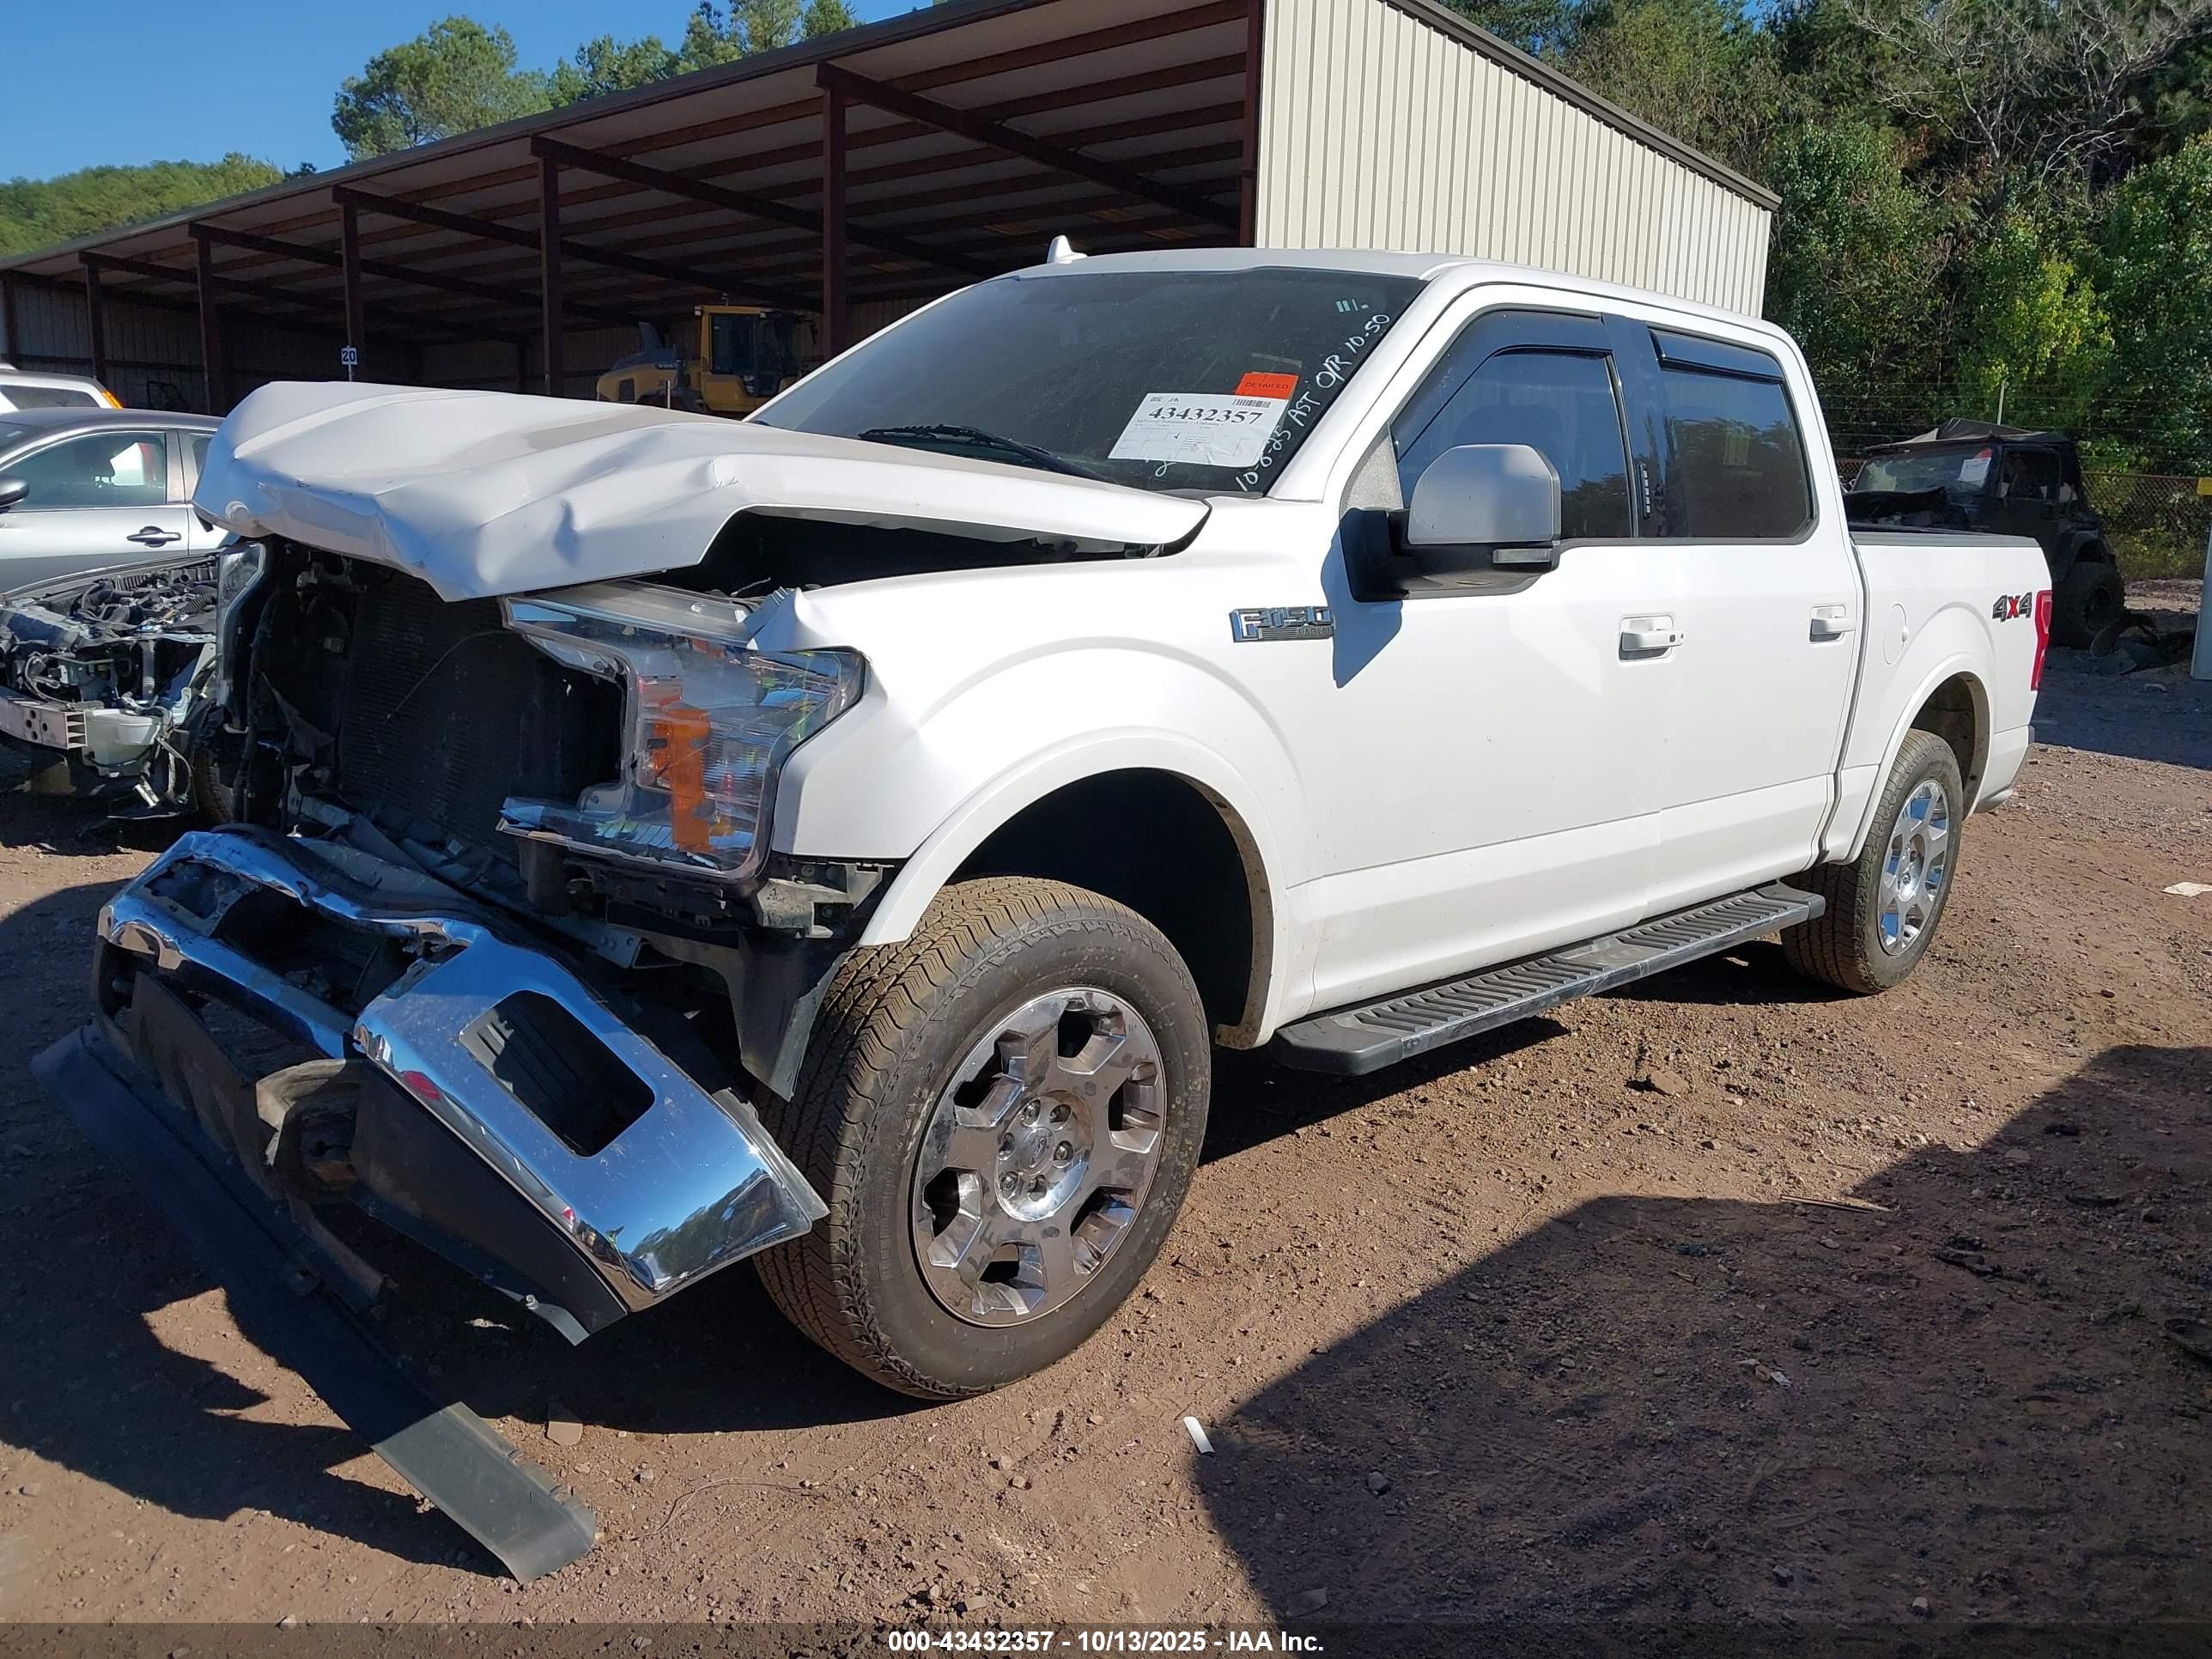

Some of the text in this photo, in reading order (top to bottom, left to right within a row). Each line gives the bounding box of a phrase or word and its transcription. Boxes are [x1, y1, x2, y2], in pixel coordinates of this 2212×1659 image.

[343, 350, 356, 362] 20
[1287, 391, 1323, 427] AST
[1344, 313, 1391, 354] 10-50
[1244, 381, 1289, 390] DETAILED
[1148, 406, 1263, 425] 43432357
